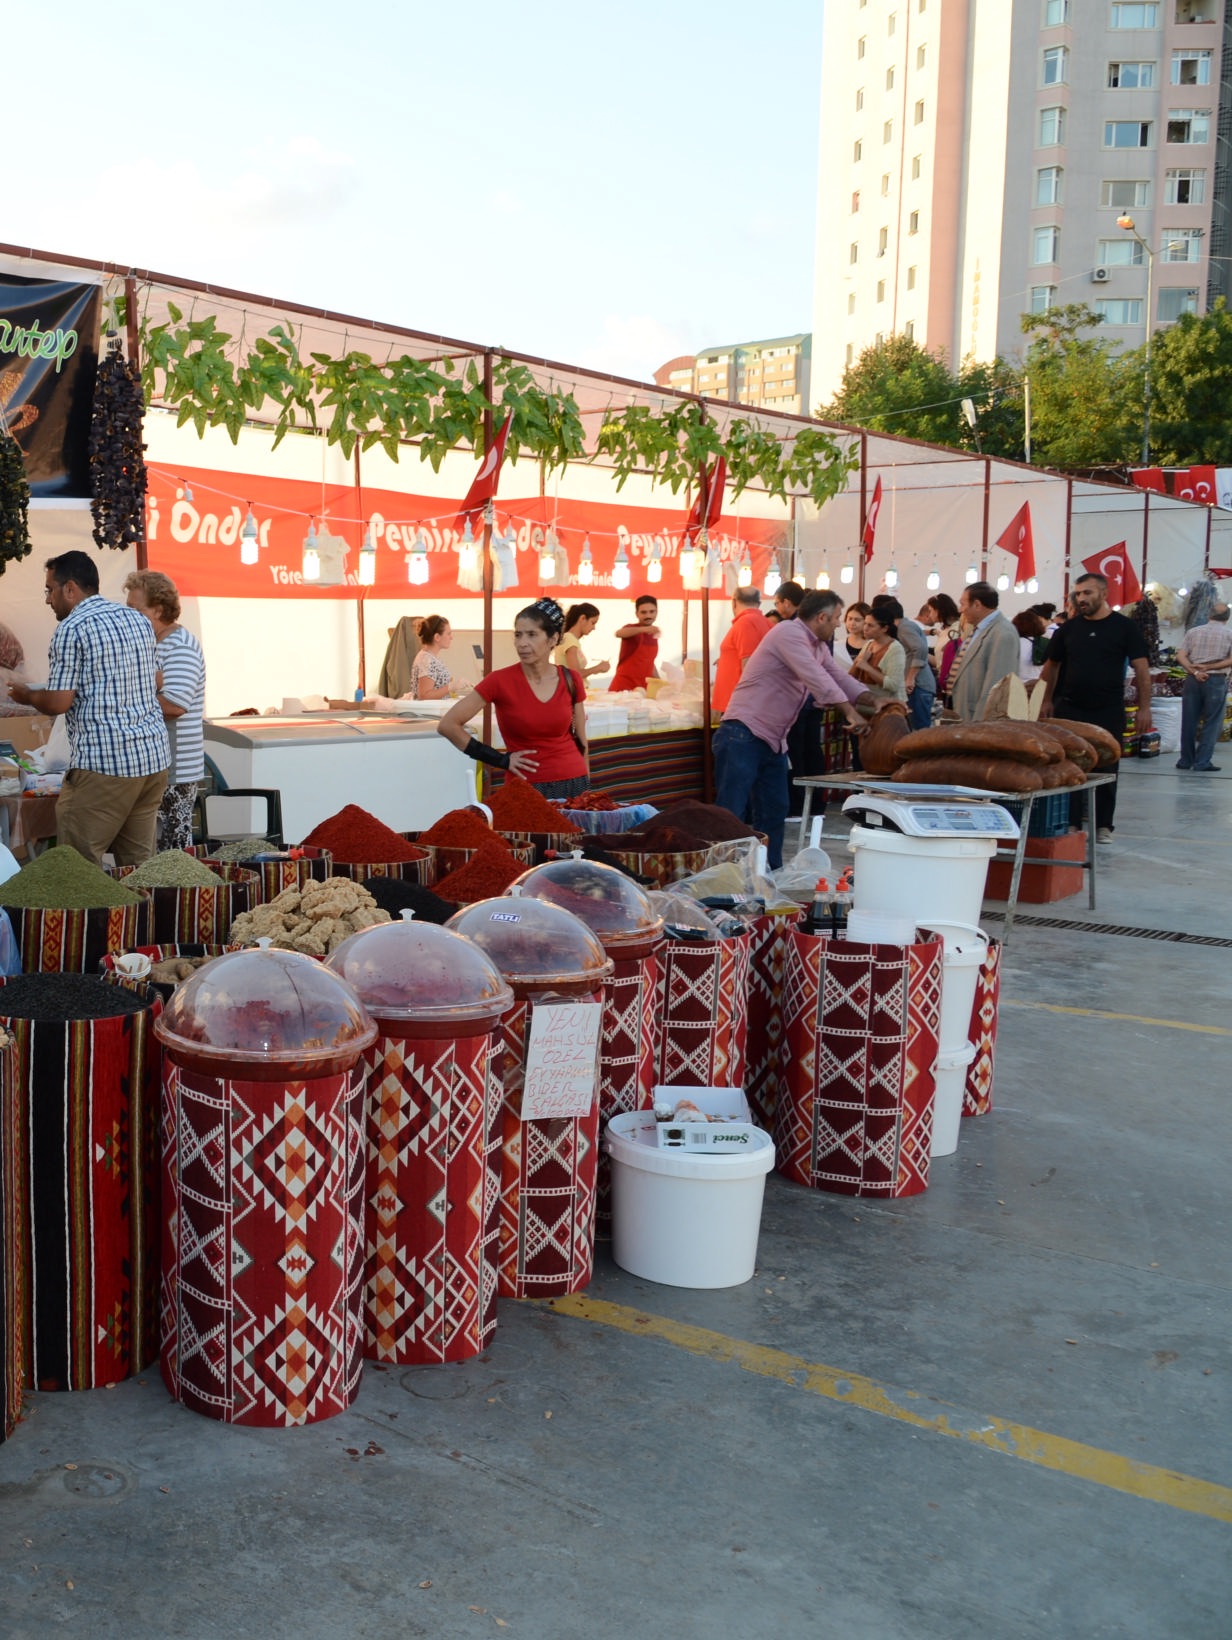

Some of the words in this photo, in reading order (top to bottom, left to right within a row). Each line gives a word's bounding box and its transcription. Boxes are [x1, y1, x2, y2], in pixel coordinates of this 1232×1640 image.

[369, 512, 461, 563] Peynirc
[617, 525, 681, 566] Peynir
[492, 913, 519, 922] TATLI
